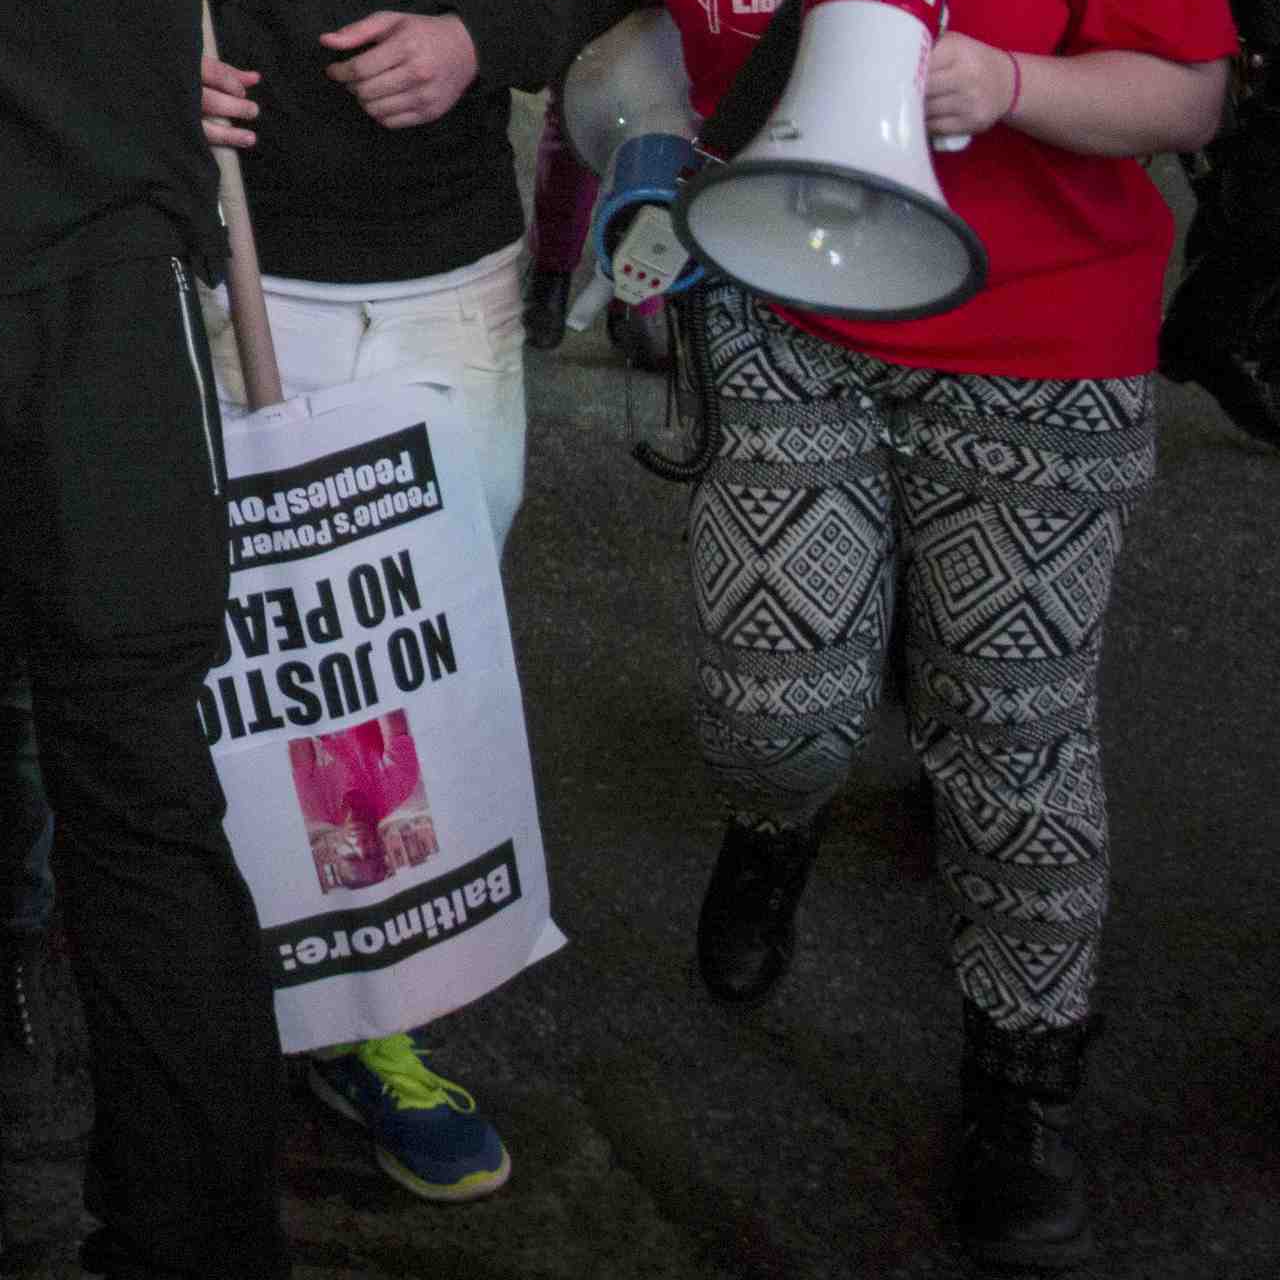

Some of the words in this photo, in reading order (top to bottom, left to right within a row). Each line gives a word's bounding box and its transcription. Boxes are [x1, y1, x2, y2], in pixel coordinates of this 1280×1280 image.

[241, 523, 333, 559] Power
[334, 481, 439, 535] People's
[347, 549, 422, 629] NO
[386, 612, 458, 693] NO
[279, 863, 513, 971] Baltimore:
